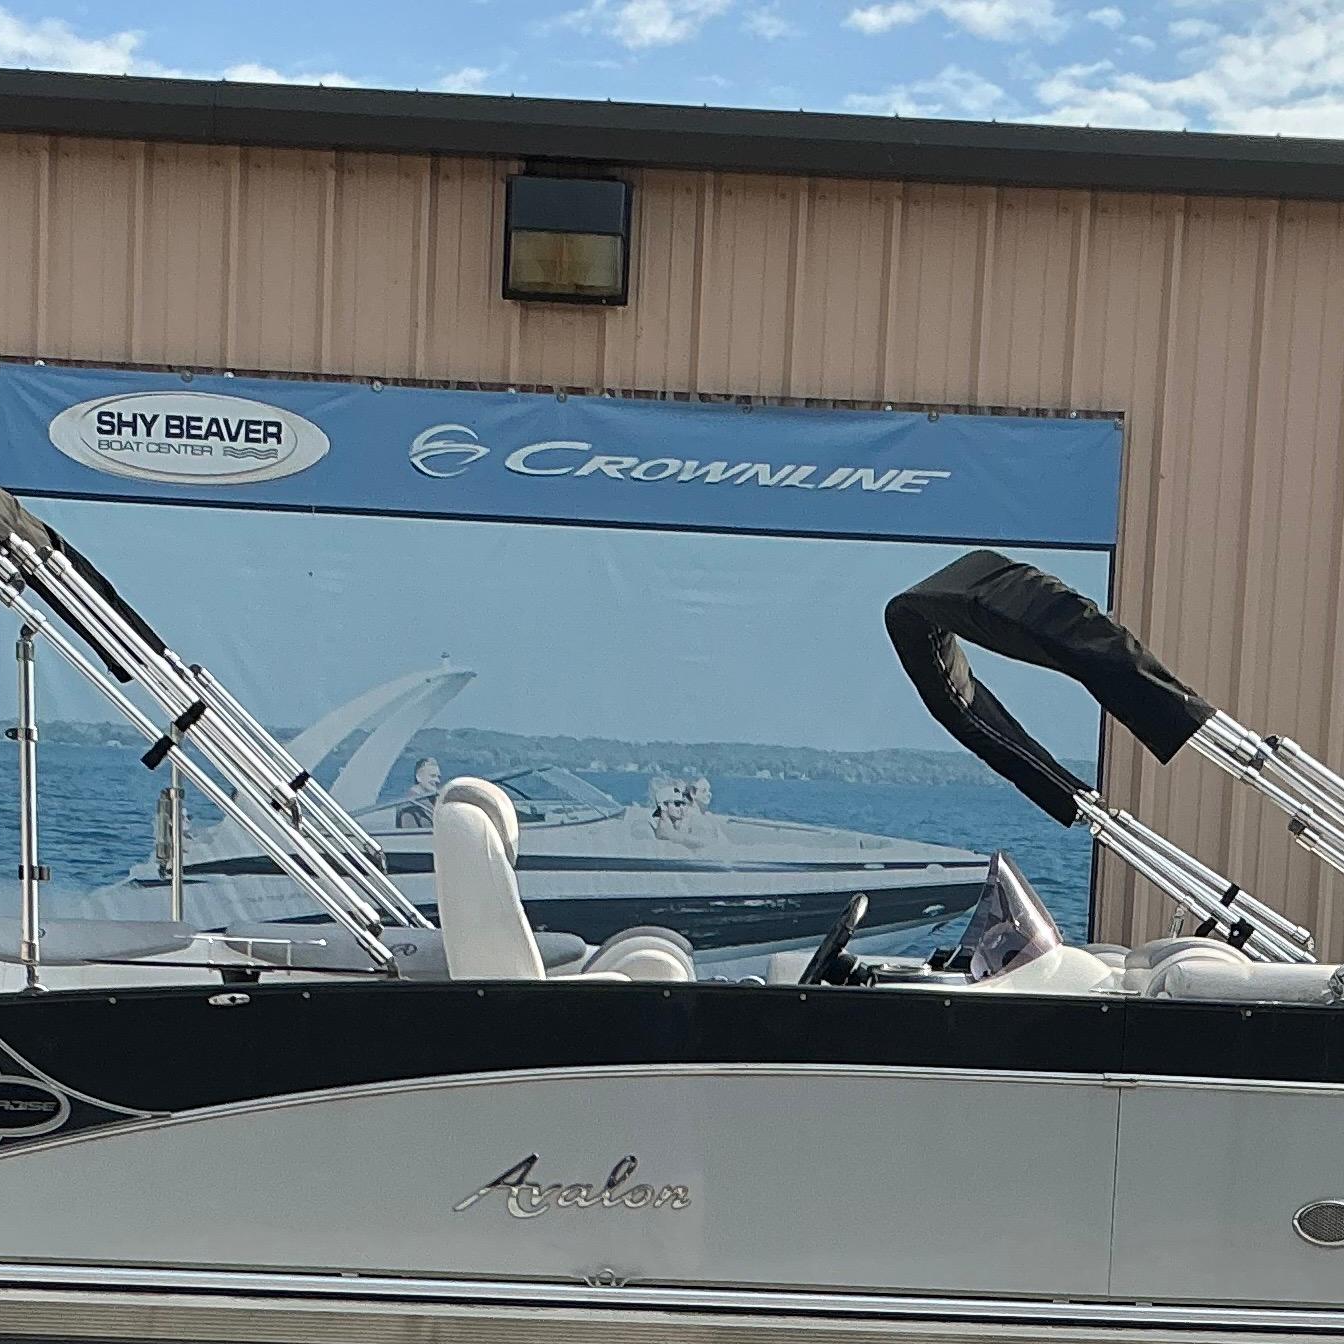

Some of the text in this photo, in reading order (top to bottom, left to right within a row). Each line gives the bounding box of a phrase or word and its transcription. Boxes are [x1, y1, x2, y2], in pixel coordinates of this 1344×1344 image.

[97, 411, 283, 445] SHY BEAVER
[97, 439, 214, 457] BOAT CENTER
[505, 441, 951, 494] CROWNLINE
[452, 1152, 692, 1219] Avalon
